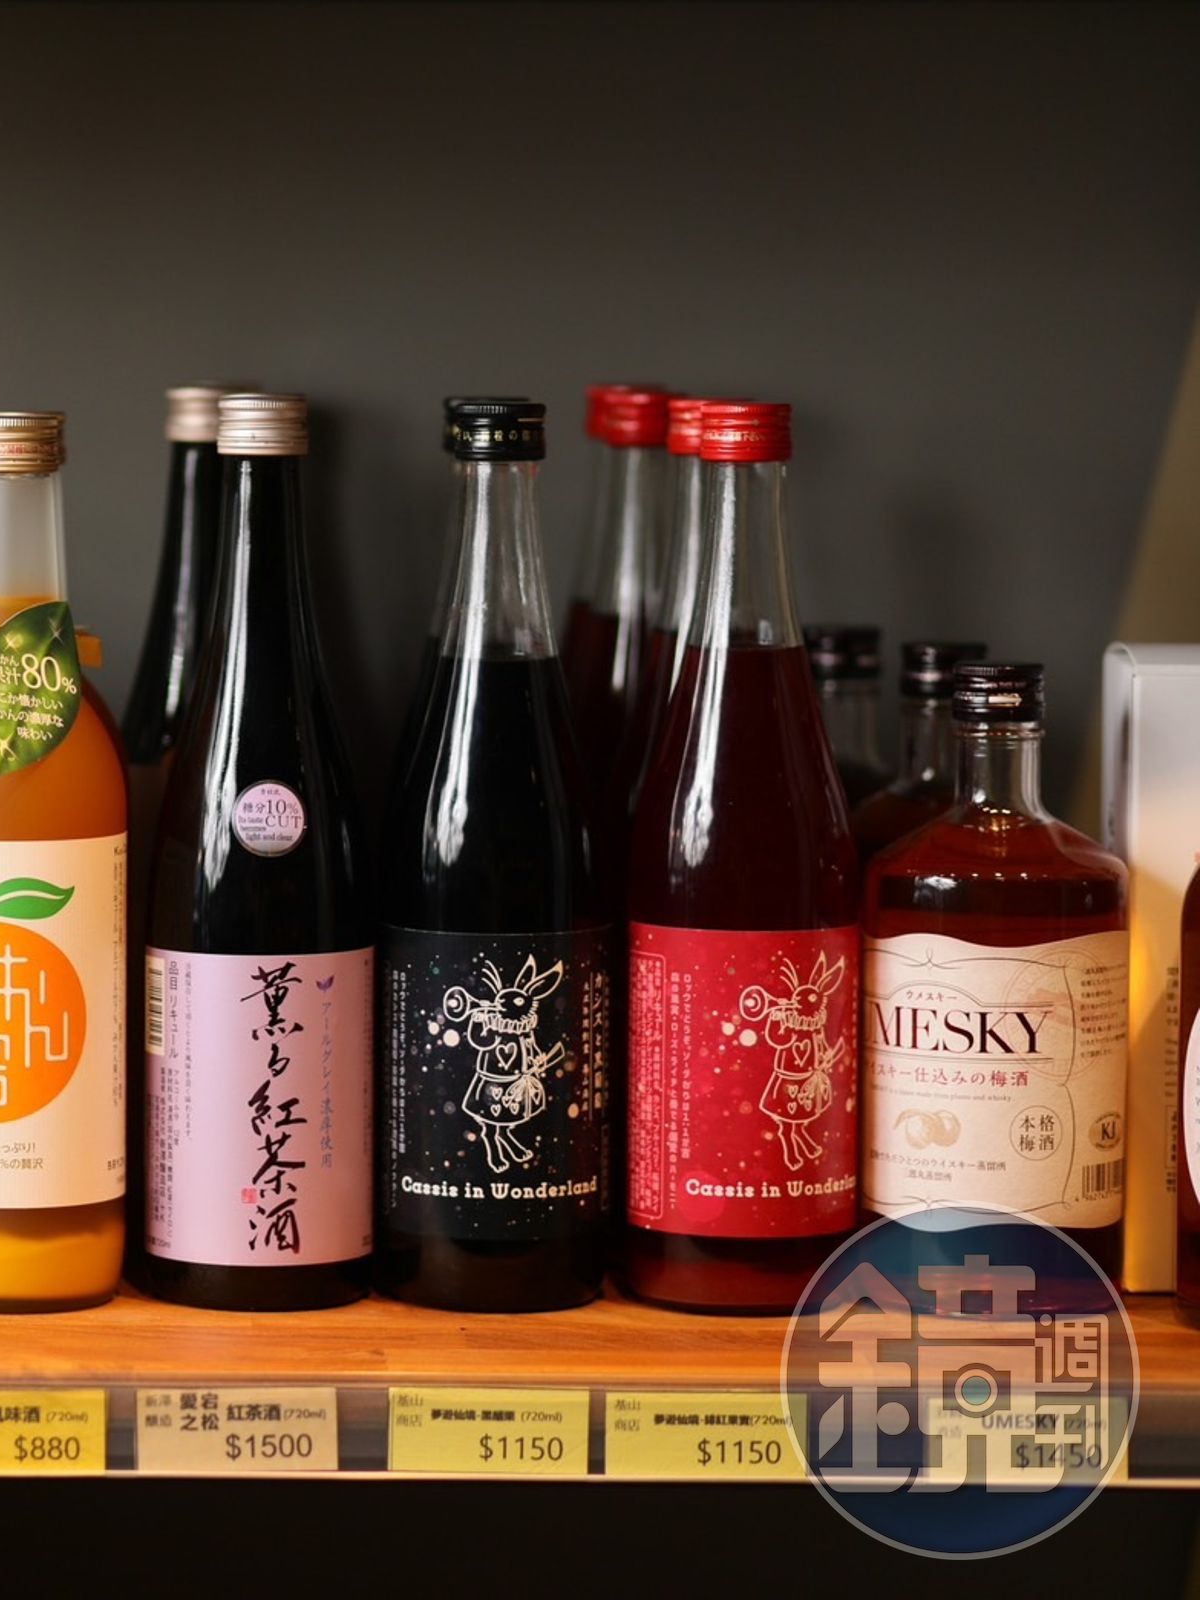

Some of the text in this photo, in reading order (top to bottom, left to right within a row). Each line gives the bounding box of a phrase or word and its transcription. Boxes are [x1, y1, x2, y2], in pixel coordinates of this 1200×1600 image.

[17, 726, 52, 740] 味わい
[265, 815, 302, 829] CUT
[869, 1001, 1054, 1055] MESKY
[1019, 1113, 1055, 1132] 本格
[1019, 1133, 1055, 1152] 梅酒
[401, 1175, 598, 1200] Cassis in Wonderland
[685, 1178, 755, 1198] Cassis
[761, 1180, 781, 1199] in
[226, 1403, 282, 1422] 紅茶酒
[520, 1411, 564, 1423] (720ml)
[980, 1413, 1060, 1430] UMESKY
[14, 1434, 81, 1462] $880
[225, 1433, 313, 1461] $1500
[479, 1433, 564, 1462] $1150
[697, 1438, 783, 1466] $1150
[1015, 1442, 1103, 1469] $1450
